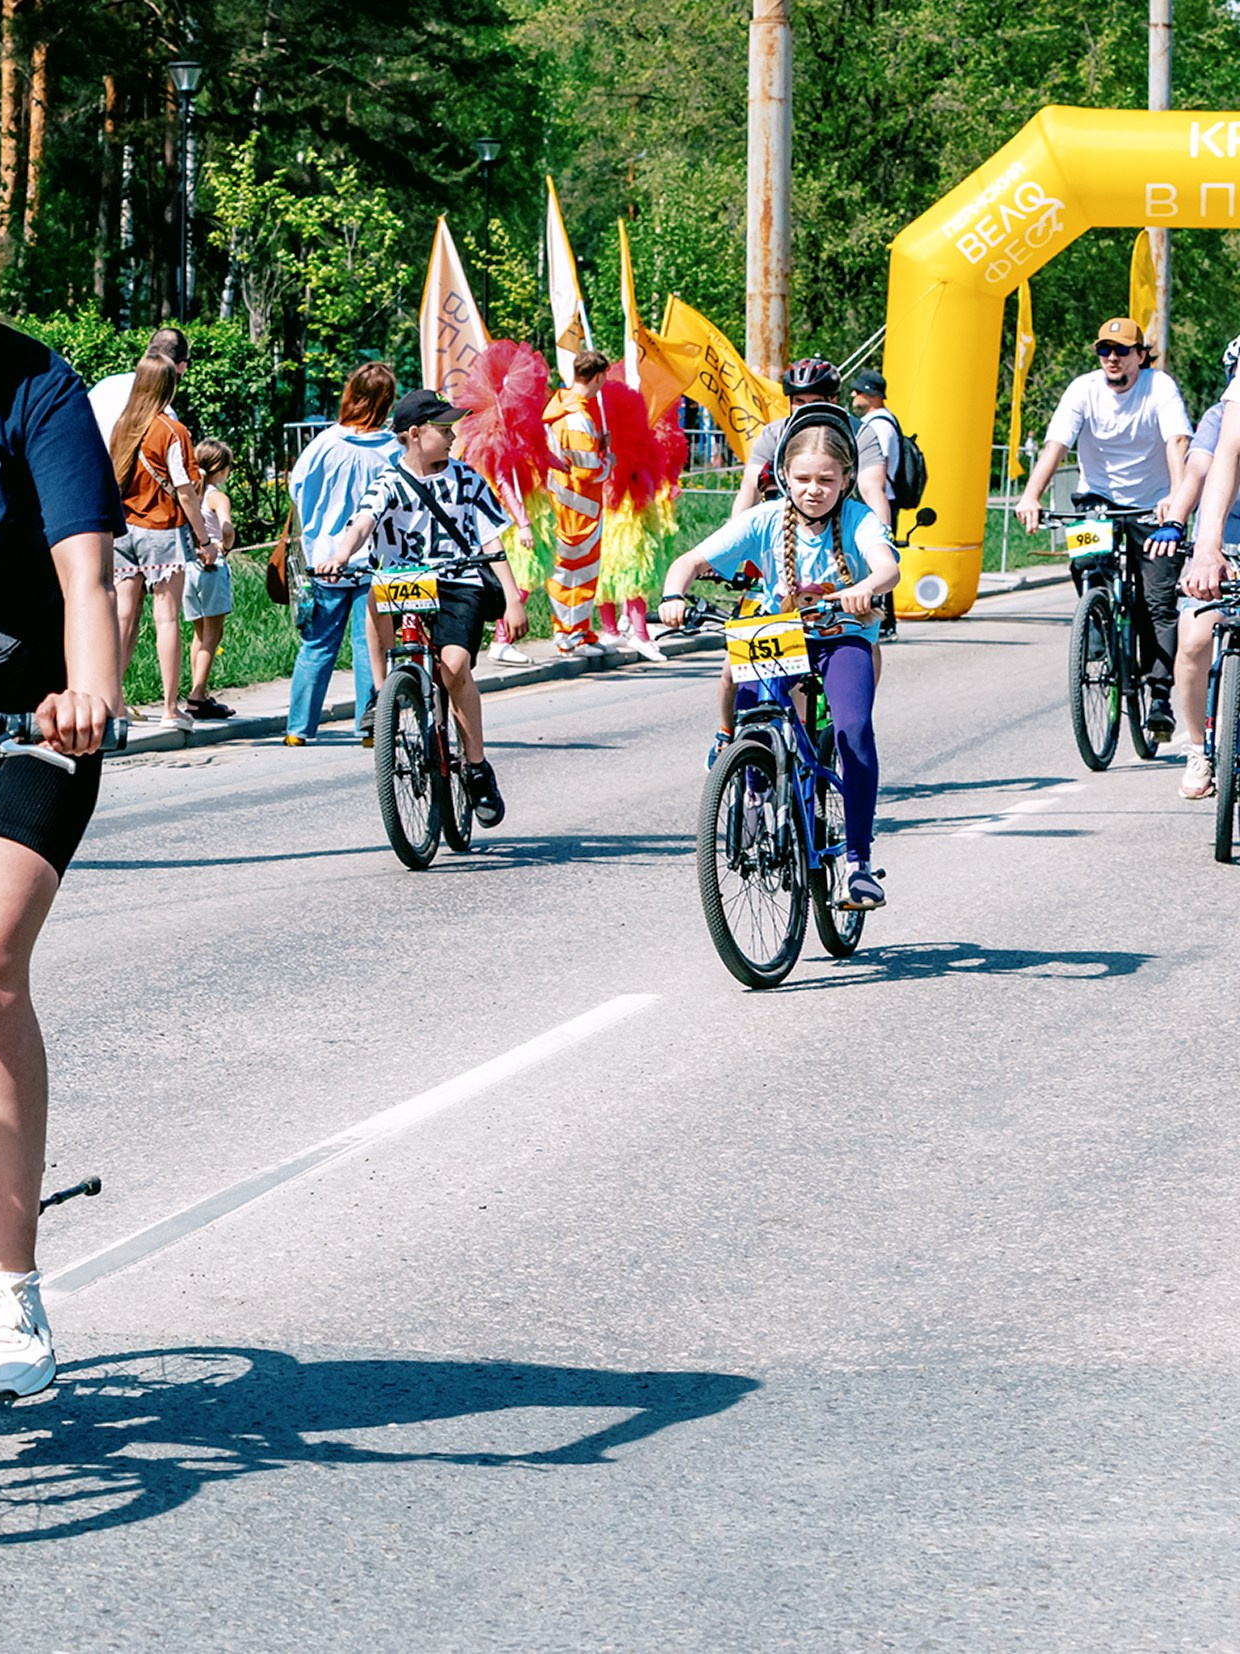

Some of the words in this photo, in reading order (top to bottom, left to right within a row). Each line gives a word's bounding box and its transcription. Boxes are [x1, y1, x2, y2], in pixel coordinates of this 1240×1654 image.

[1145, 182, 1179, 218] В
[955, 181, 1050, 265] ВЕЛО
[984, 202, 1064, 284] ФЕСТ
[389, 584, 421, 600] 744
[750, 637, 784, 660] 151
